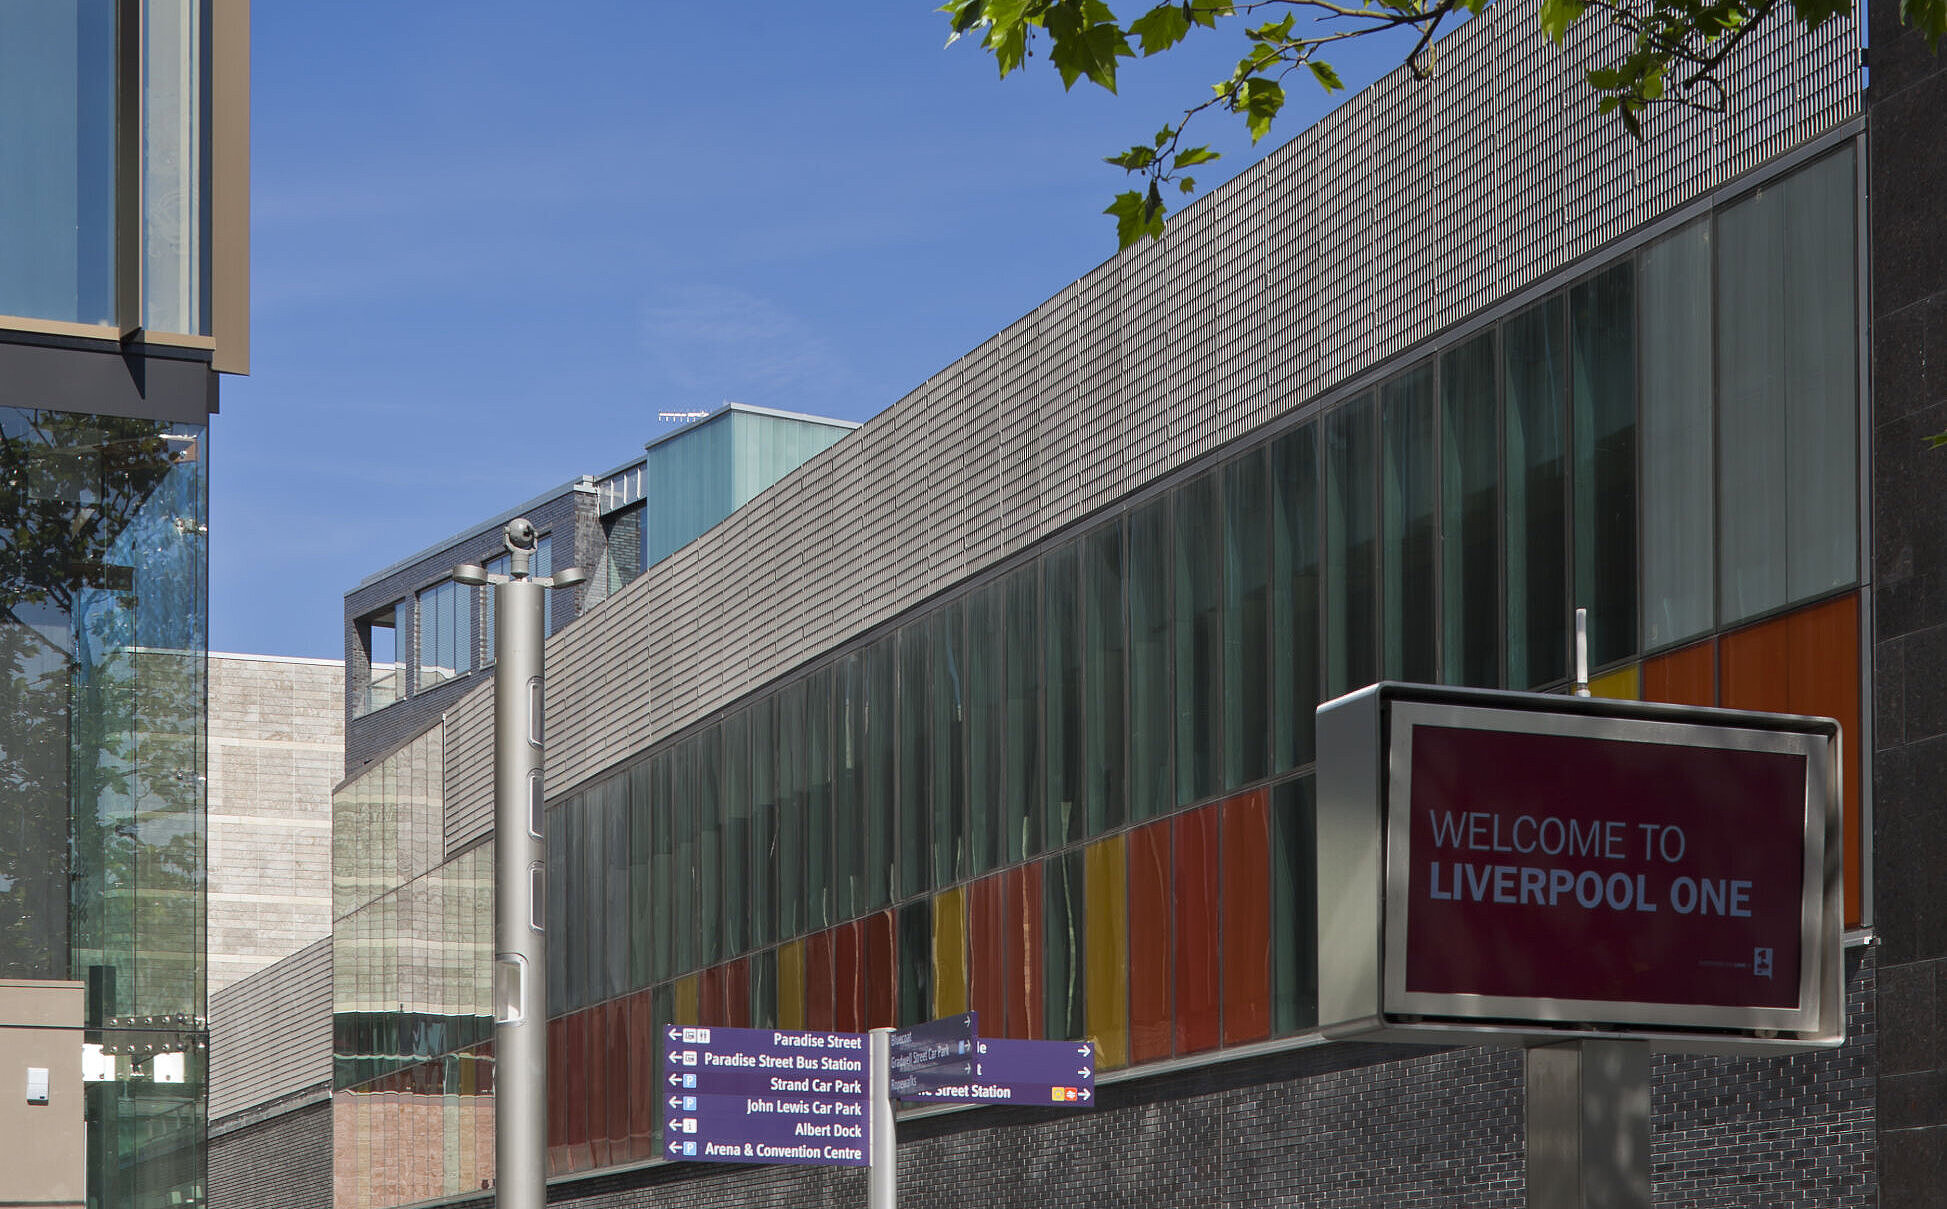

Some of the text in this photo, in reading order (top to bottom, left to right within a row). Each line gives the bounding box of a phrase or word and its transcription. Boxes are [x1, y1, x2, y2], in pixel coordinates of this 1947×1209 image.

[1429, 809, 1685, 863] WELCOME TO
[1429, 861, 1752, 917] LIVERPOOL ONE
[774, 1032, 862, 1050] Paradise Street
[704, 1052, 862, 1071] Paradise Street Bus Station
[913, 1050, 928, 1064] Street
[928, 1047, 938, 1061] Car
[938, 1043, 950, 1057] Park
[770, 1077, 809, 1092] Strand
[812, 1078, 832, 1093] Car
[835, 1079, 862, 1094] Park
[971, 1084, 1011, 1099] Station
[746, 1098, 774, 1114] John
[776, 1099, 809, 1114] Lewis
[812, 1101, 832, 1115] Car
[835, 1102, 862, 1116] Park
[795, 1122, 831, 1137] Albert
[834, 1123, 862, 1138] Dock
[705, 1142, 741, 1156] Arena
[743, 1142, 754, 1157] &
[756, 1143, 821, 1159] Convention
[823, 1145, 862, 1160] Centre
